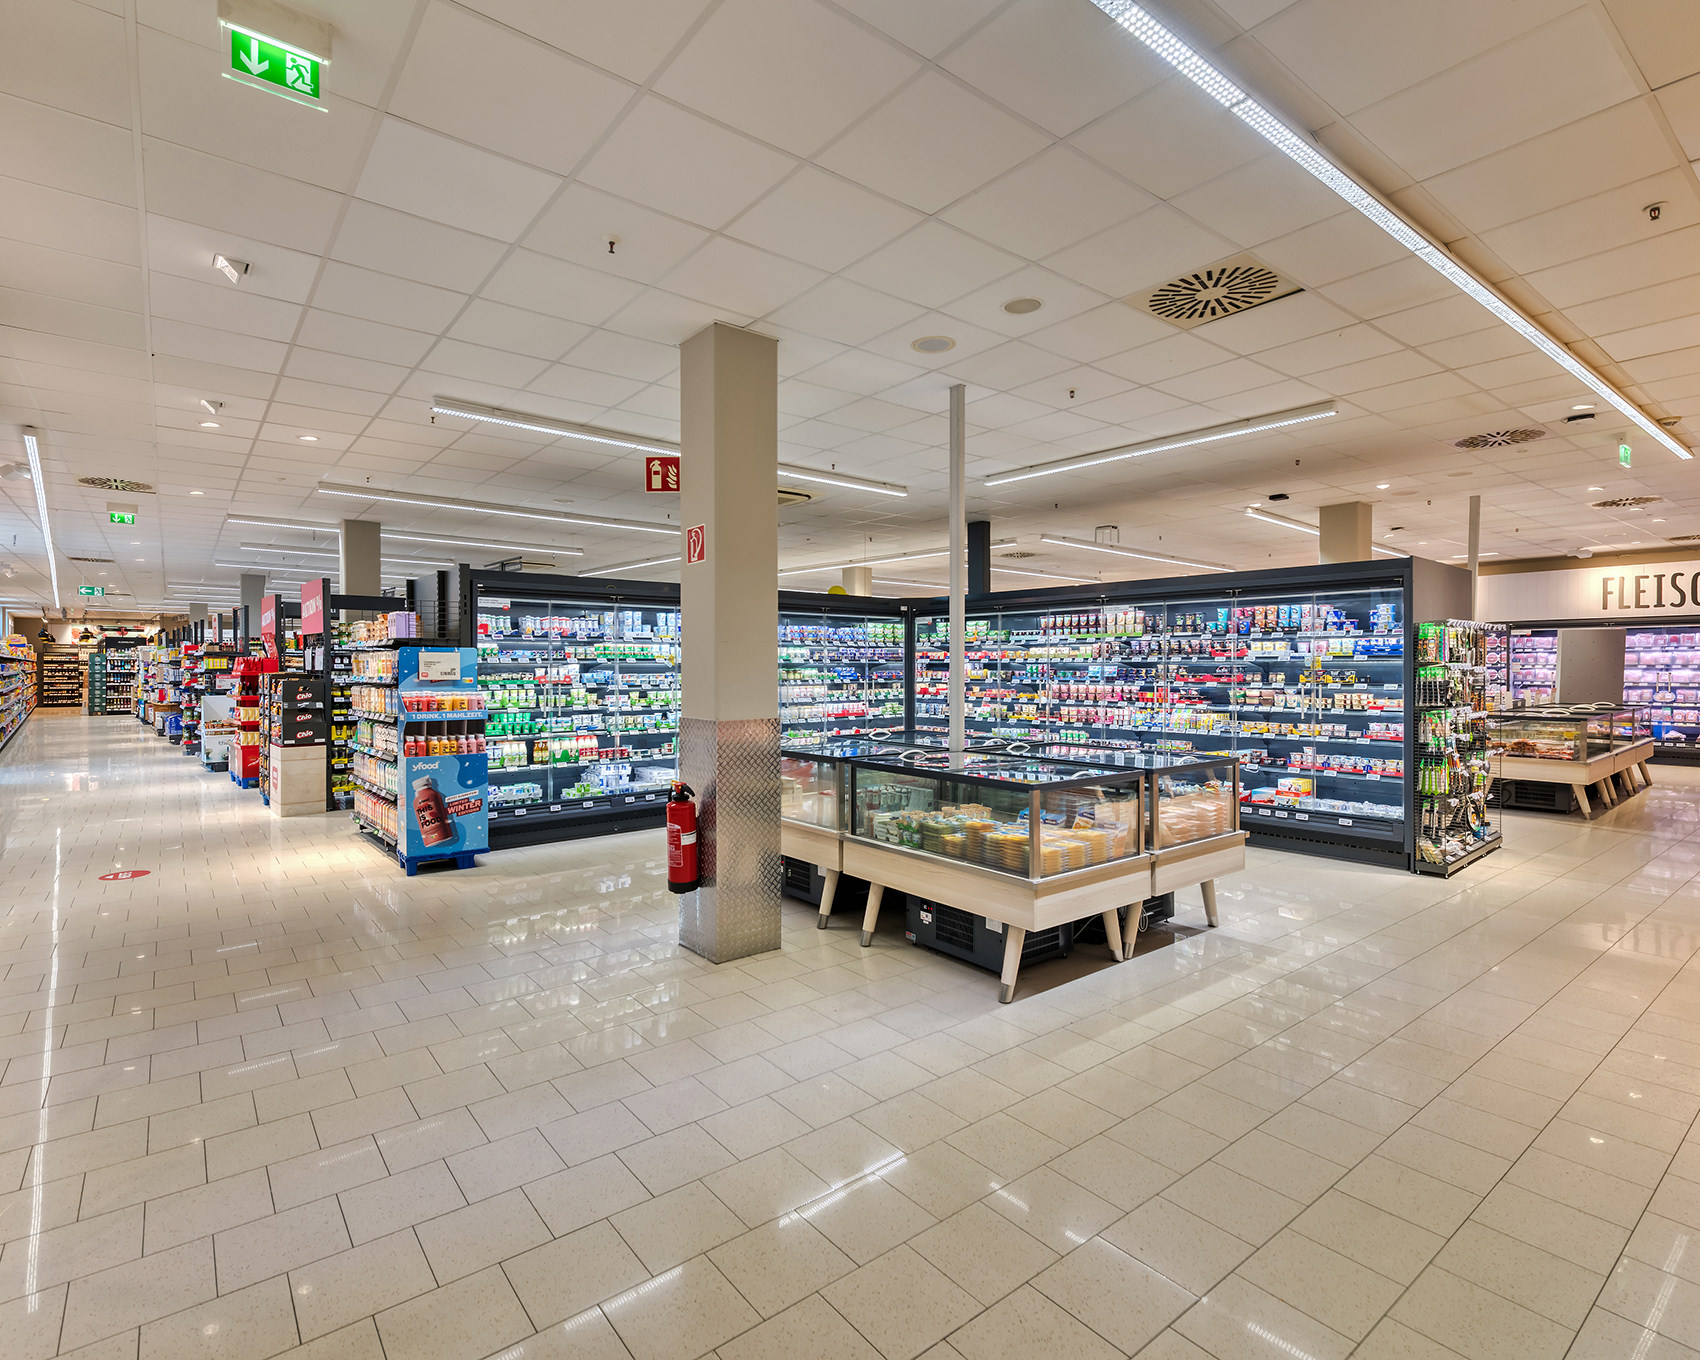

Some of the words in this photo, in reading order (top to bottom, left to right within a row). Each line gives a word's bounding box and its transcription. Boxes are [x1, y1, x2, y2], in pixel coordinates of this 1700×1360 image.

[296, 692, 313, 700] Chio
[296, 730, 314, 738] Chio
[412, 761, 438, 771] yfood
[416, 804, 433, 815] THIS
[447, 800, 481, 814] WINTER
[421, 817, 441, 828] FOOD
